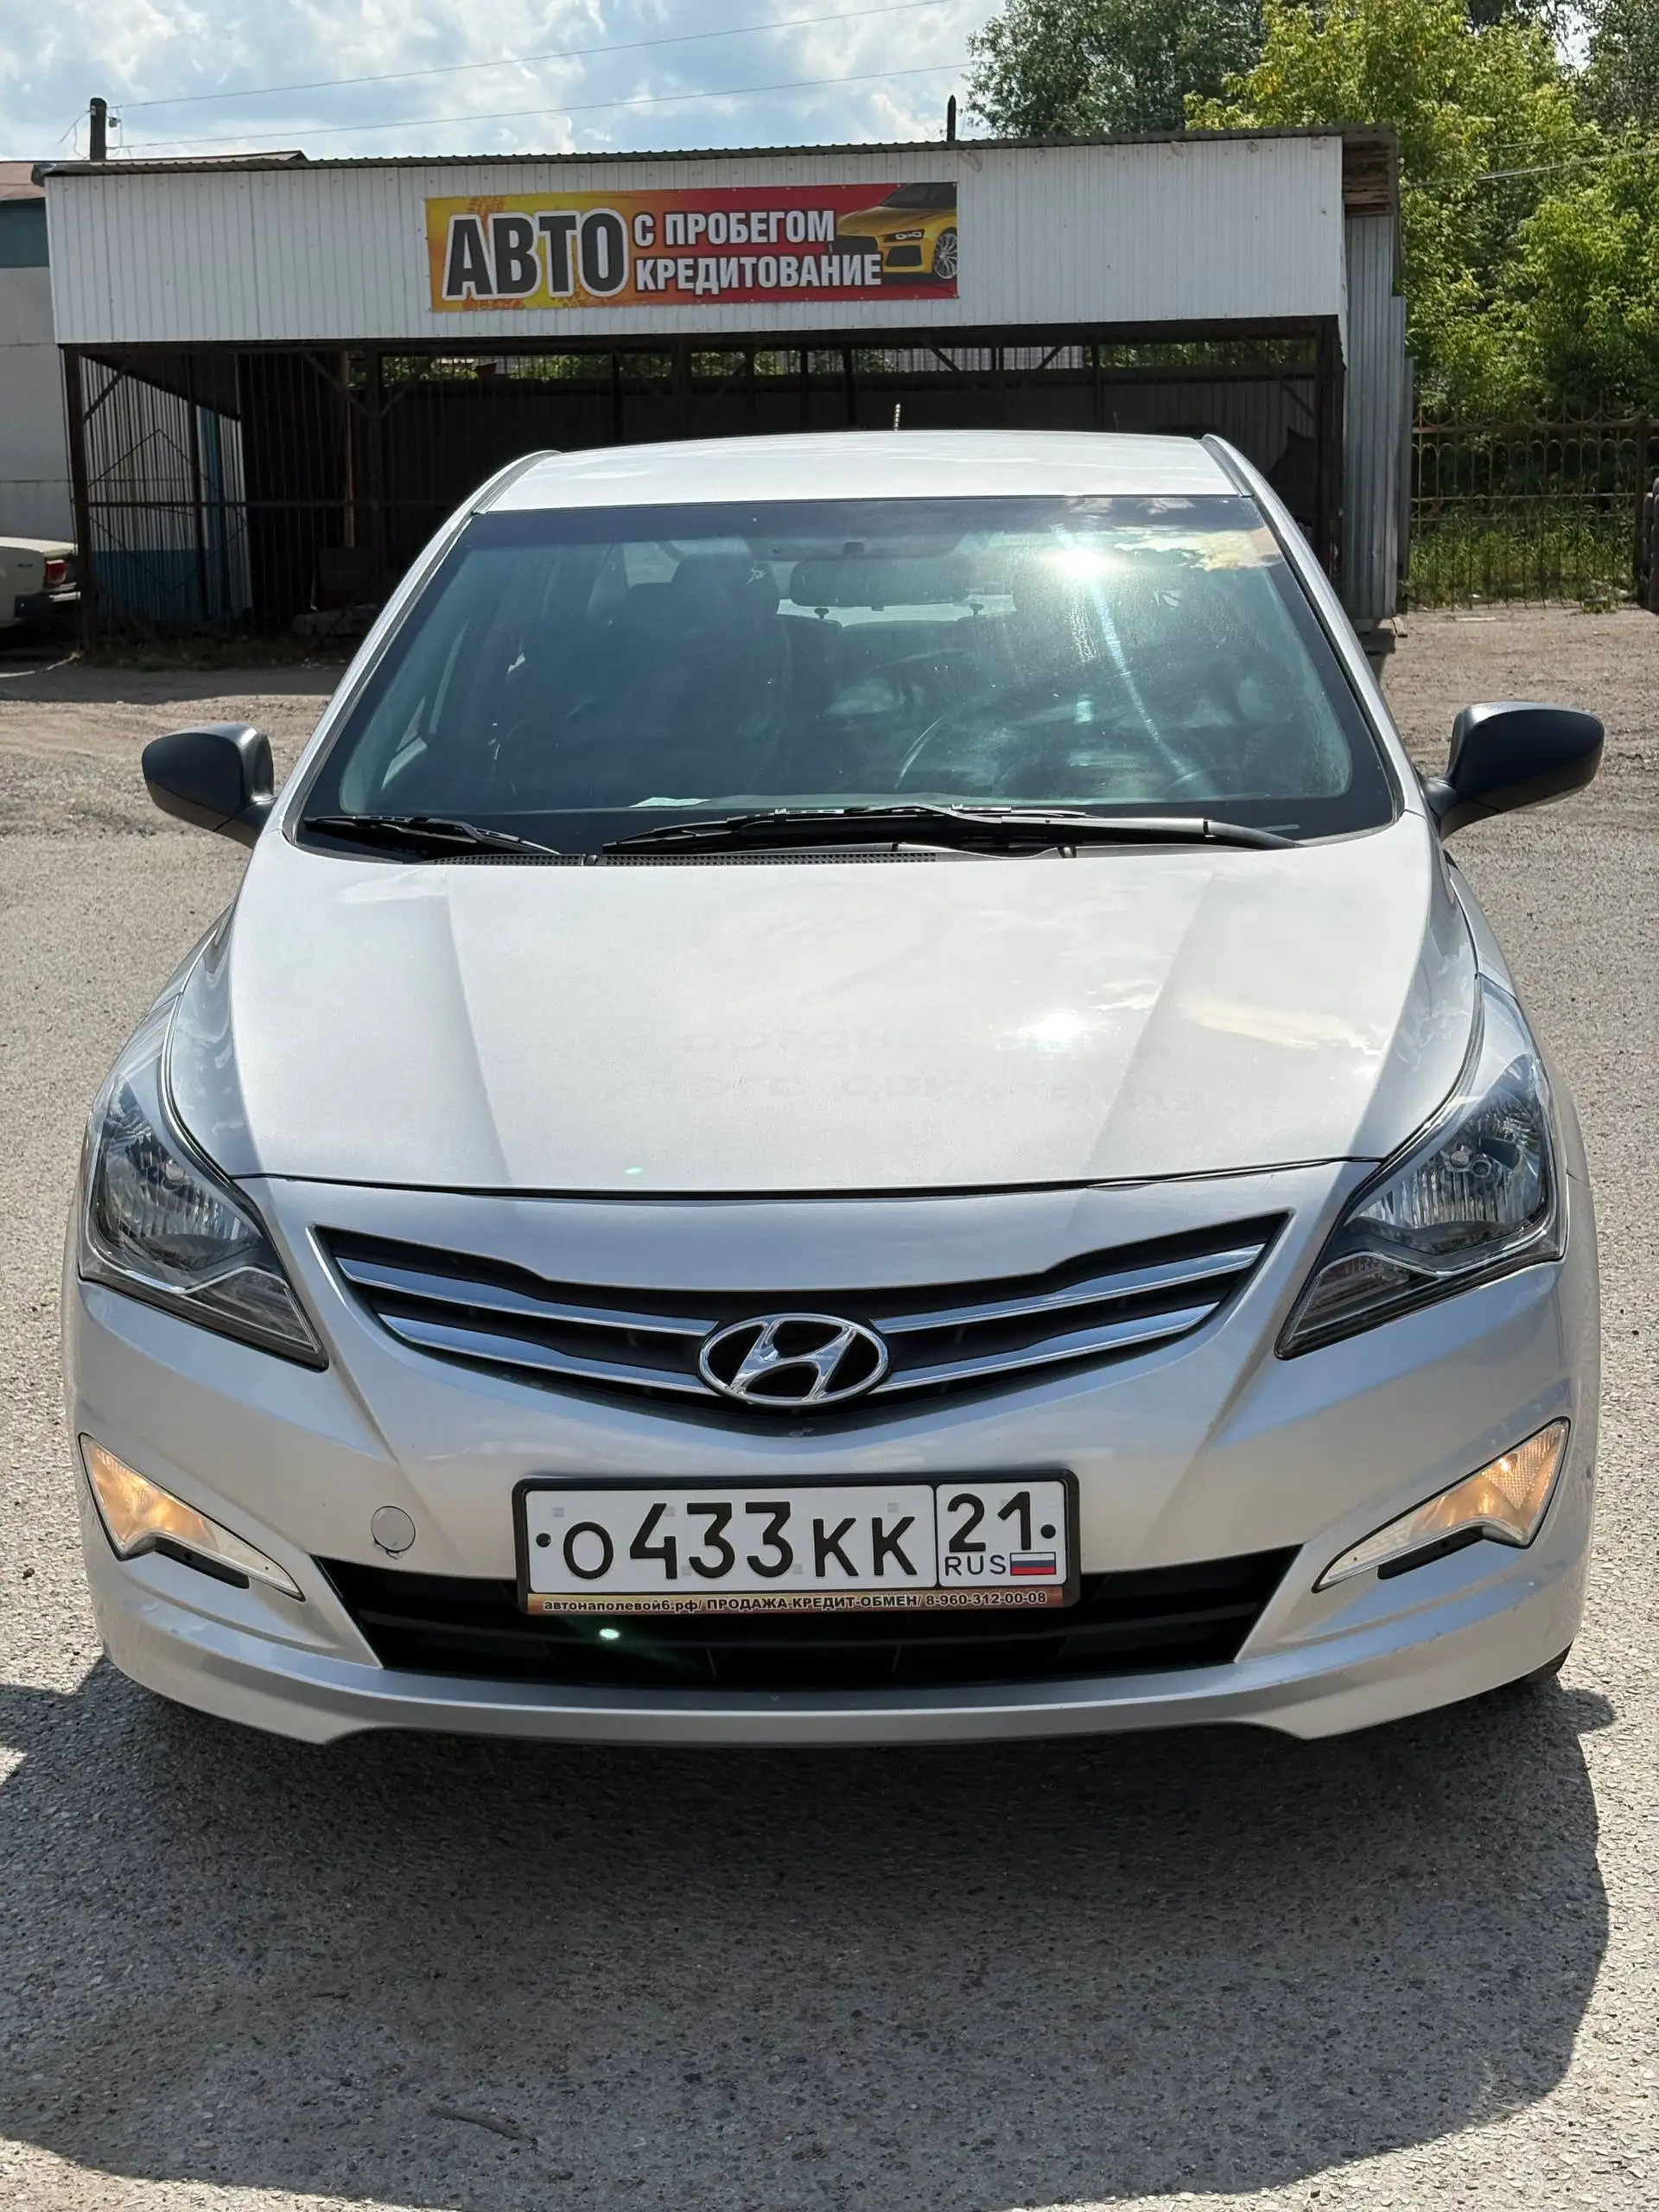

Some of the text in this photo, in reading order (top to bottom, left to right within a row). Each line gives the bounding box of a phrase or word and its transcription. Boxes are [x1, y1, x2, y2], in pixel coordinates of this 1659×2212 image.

[634, 210, 836, 246] С ПРОБЕГОМ
[442, 208, 629, 300] АВТО
[636, 253, 881, 295] КРЕДИТОВАНИЕ
[948, 1491, 1032, 1552] 21
[944, 1555, 1007, 1576] RUS
[925, 1592, 1046, 1606] 8-960-312-00-08
